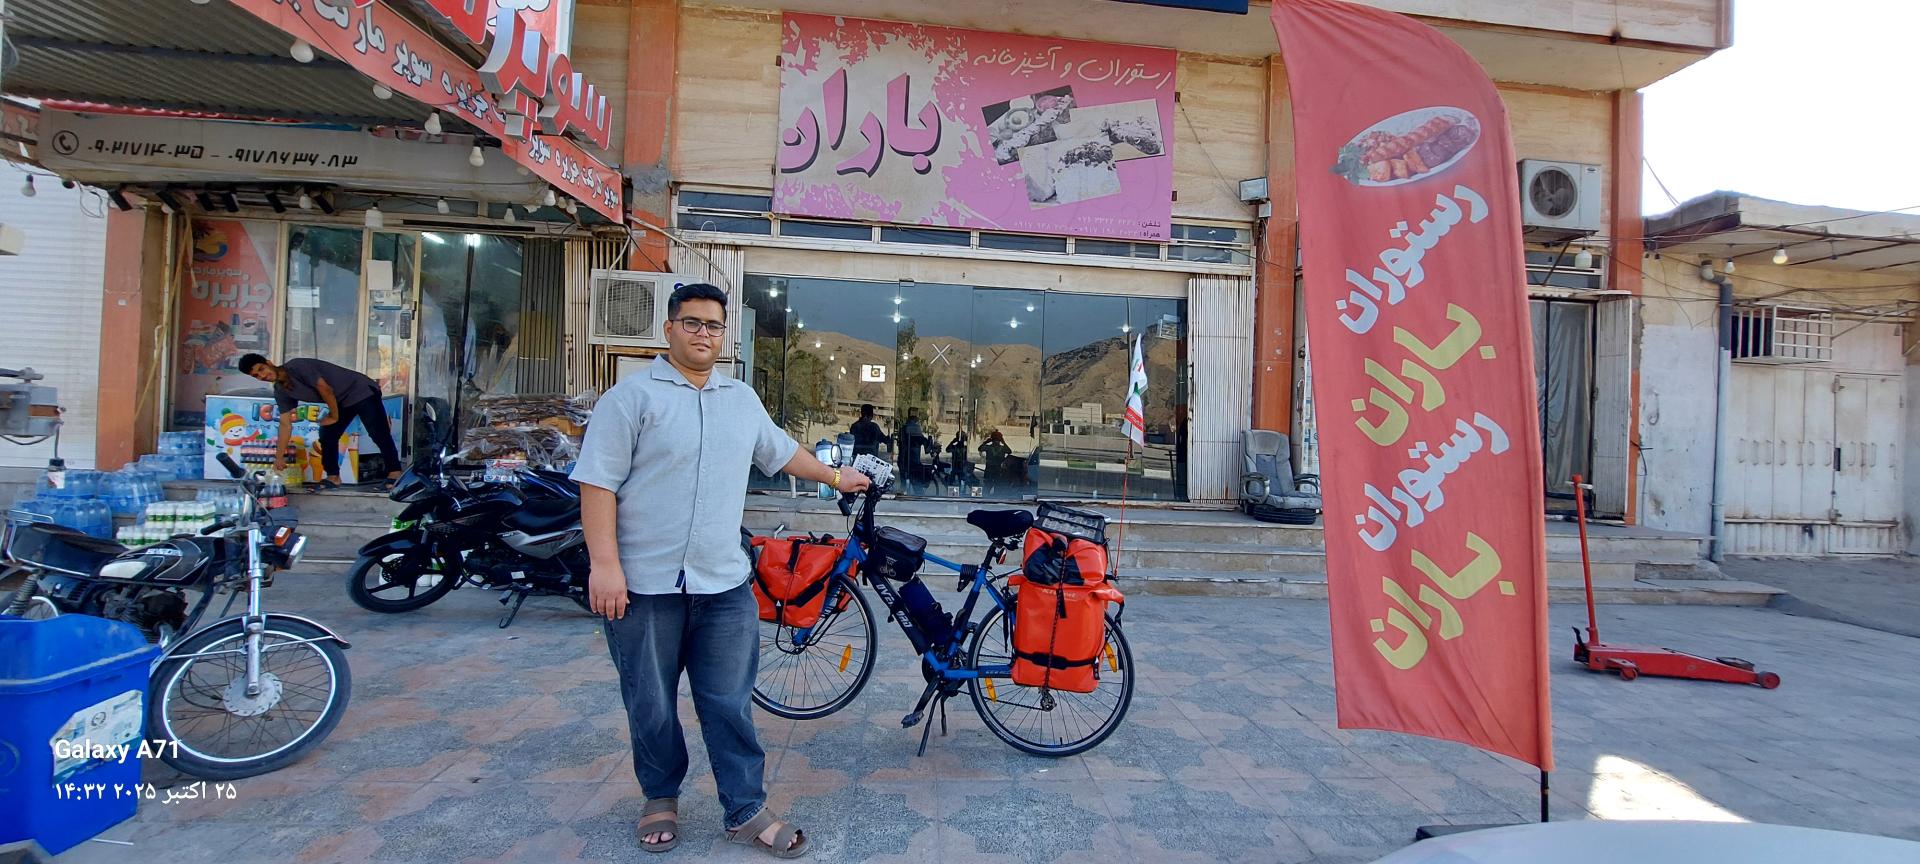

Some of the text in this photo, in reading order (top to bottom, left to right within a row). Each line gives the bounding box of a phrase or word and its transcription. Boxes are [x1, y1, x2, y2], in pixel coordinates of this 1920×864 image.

[392, 40, 433, 87] سوپر
[1059, 61, 1073, 78] و
[1078, 58, 1172, 89] رستوران
[780, 66, 942, 178] باران
[191, 273, 273, 310] جزیره
[1336, 184, 1489, 334] رستوران
[1351, 303, 1496, 446] باران
[1355, 411, 1510, 551] رستوران
[1370, 531, 1516, 670] باران
